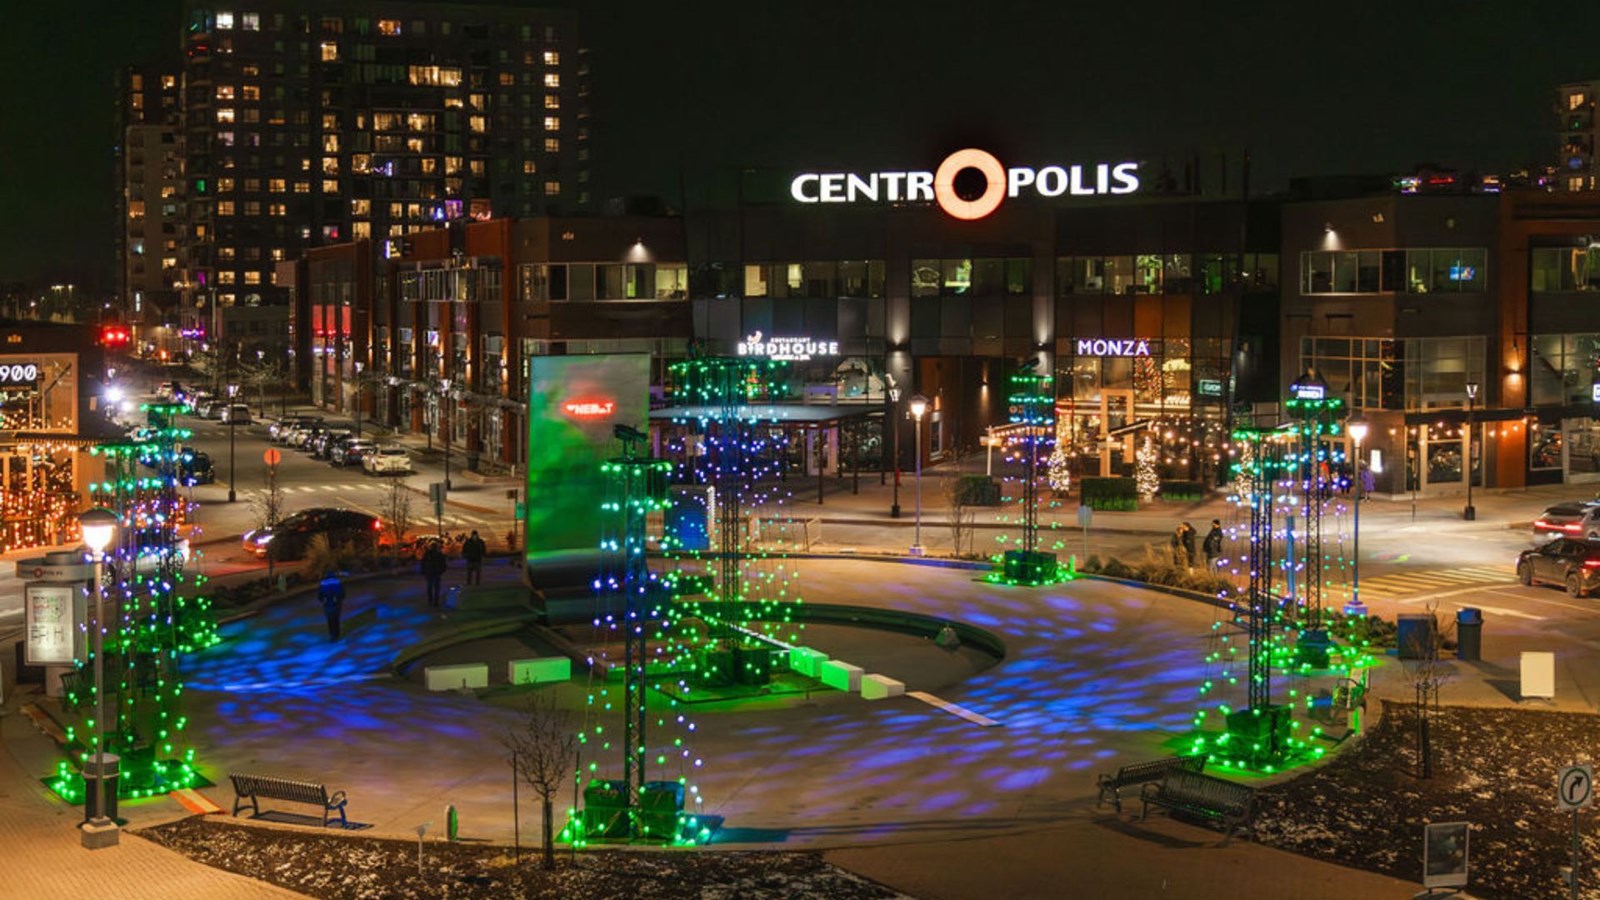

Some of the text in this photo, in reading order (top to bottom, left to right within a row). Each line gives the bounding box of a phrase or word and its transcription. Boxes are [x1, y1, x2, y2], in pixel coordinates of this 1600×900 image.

[790, 148, 1140, 219] CENTROPOLIS
[738, 341, 839, 355] BIRDHOUSE
[1077, 339, 1150, 356] MONZA
